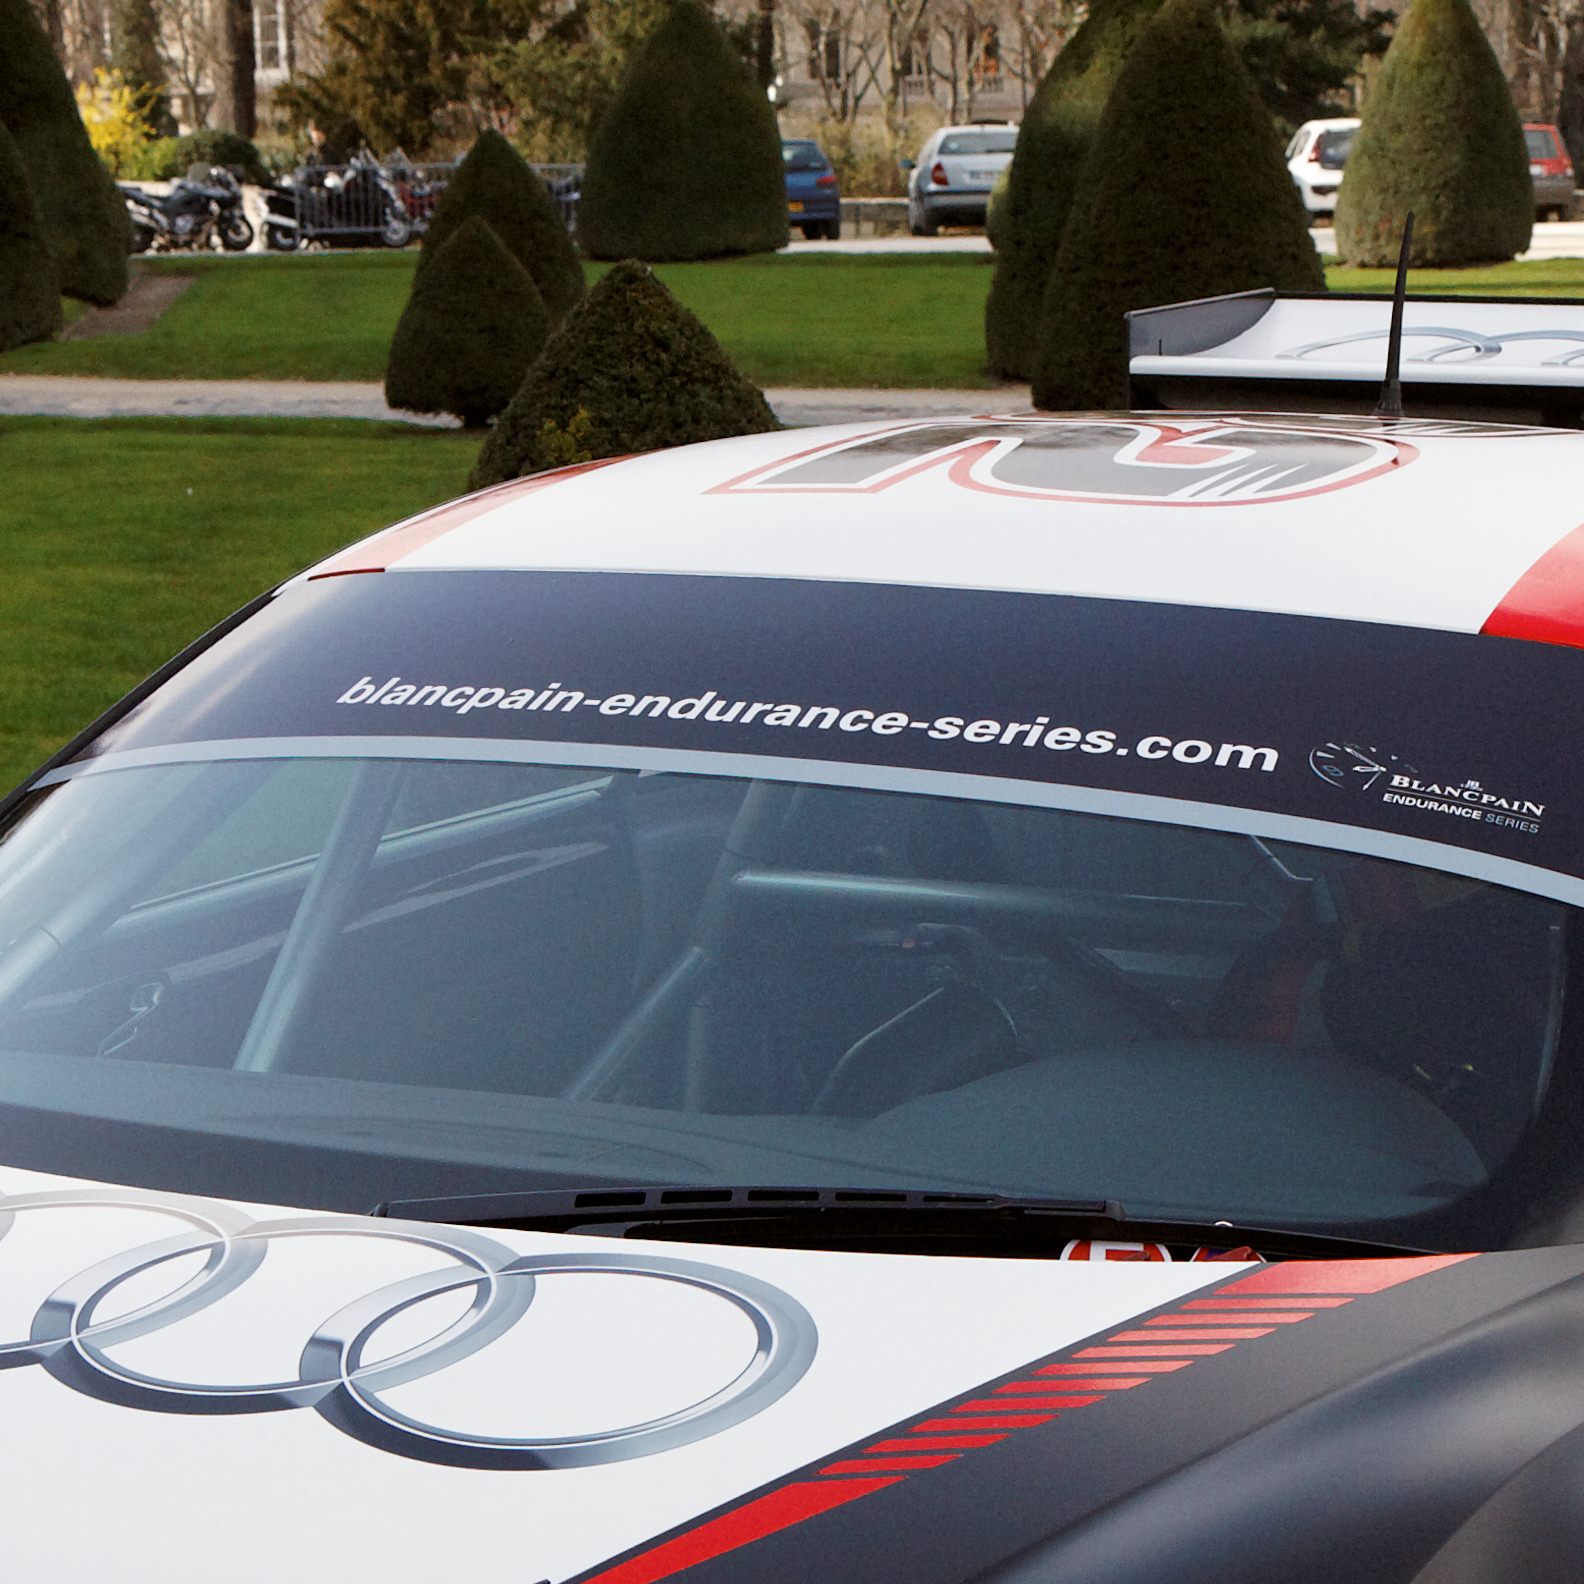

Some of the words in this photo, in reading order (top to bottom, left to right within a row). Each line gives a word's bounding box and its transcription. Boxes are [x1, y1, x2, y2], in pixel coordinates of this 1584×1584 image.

[336, 676, 1279, 772] blancpain-endurance-series.com
[1382, 793, 1483, 820] ENDURANCE
[1484, 813, 1540, 834] SERIES
[1390, 774, 1546, 817] BLANCPAIN
